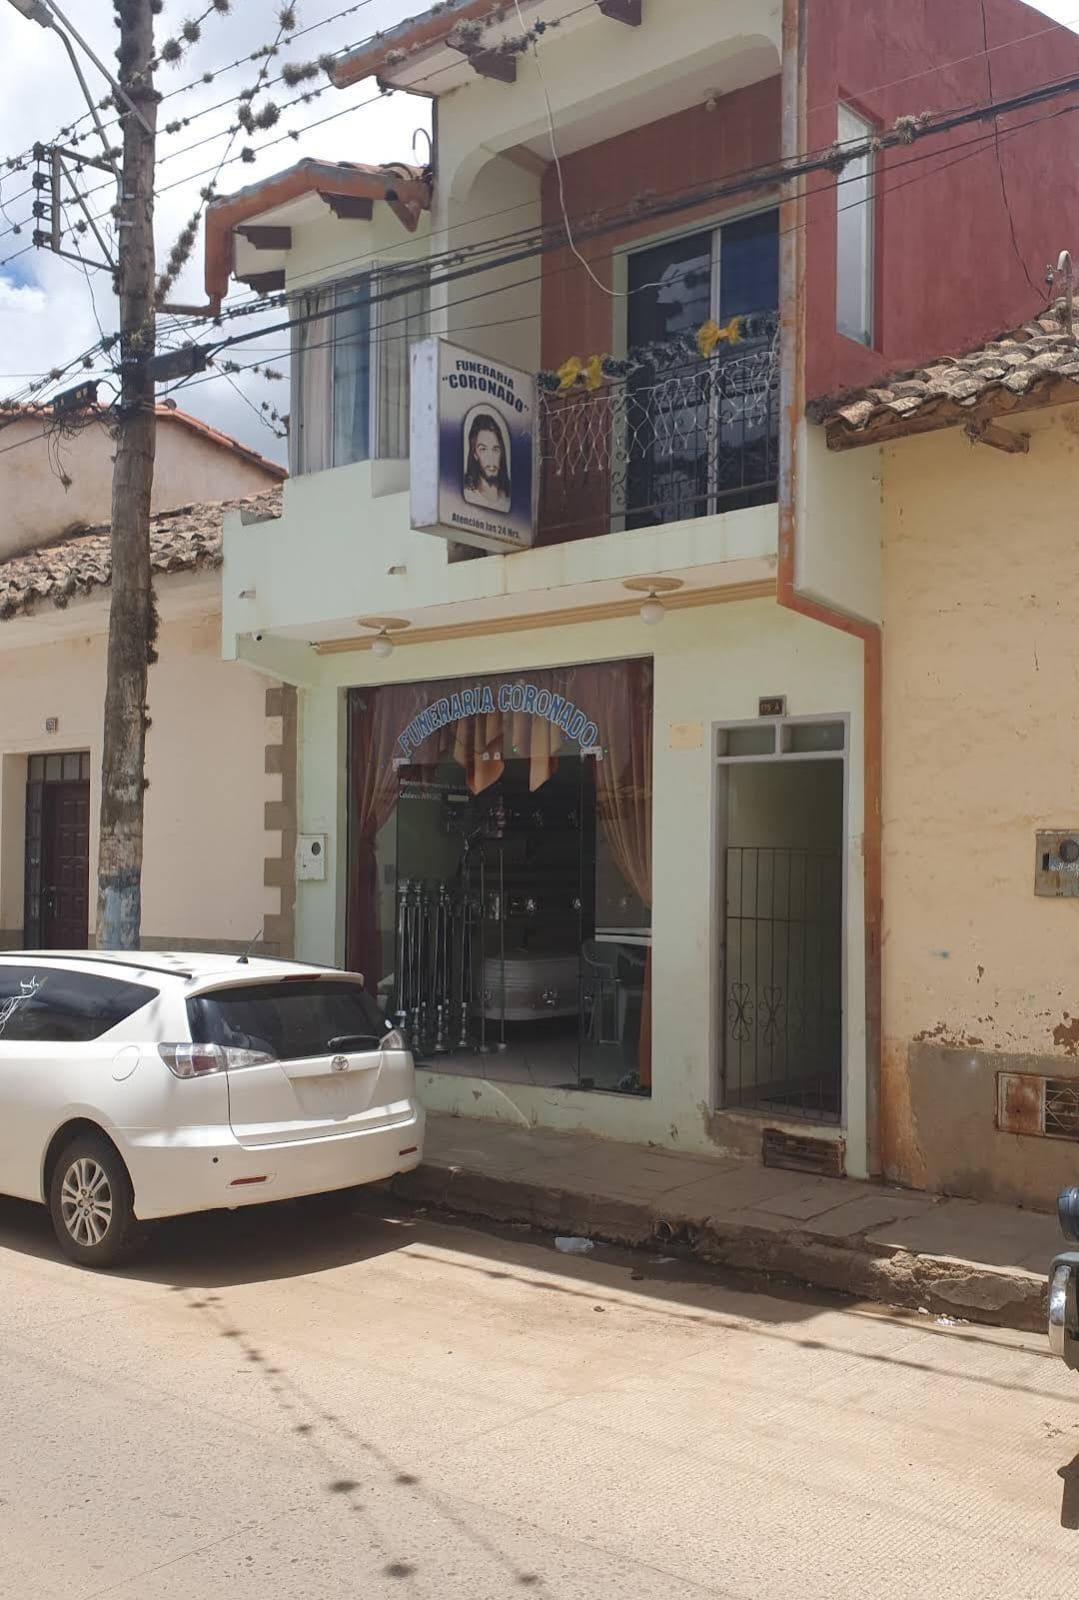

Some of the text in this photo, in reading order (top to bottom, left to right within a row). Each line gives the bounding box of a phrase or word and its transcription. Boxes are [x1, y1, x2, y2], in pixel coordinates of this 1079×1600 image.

[456, 360, 514, 390] FUNERARIA
[486, 522, 497, 533] las
[498, 525, 506, 535] 24
[398, 684, 598, 757] FUNERARIA CORONADO
